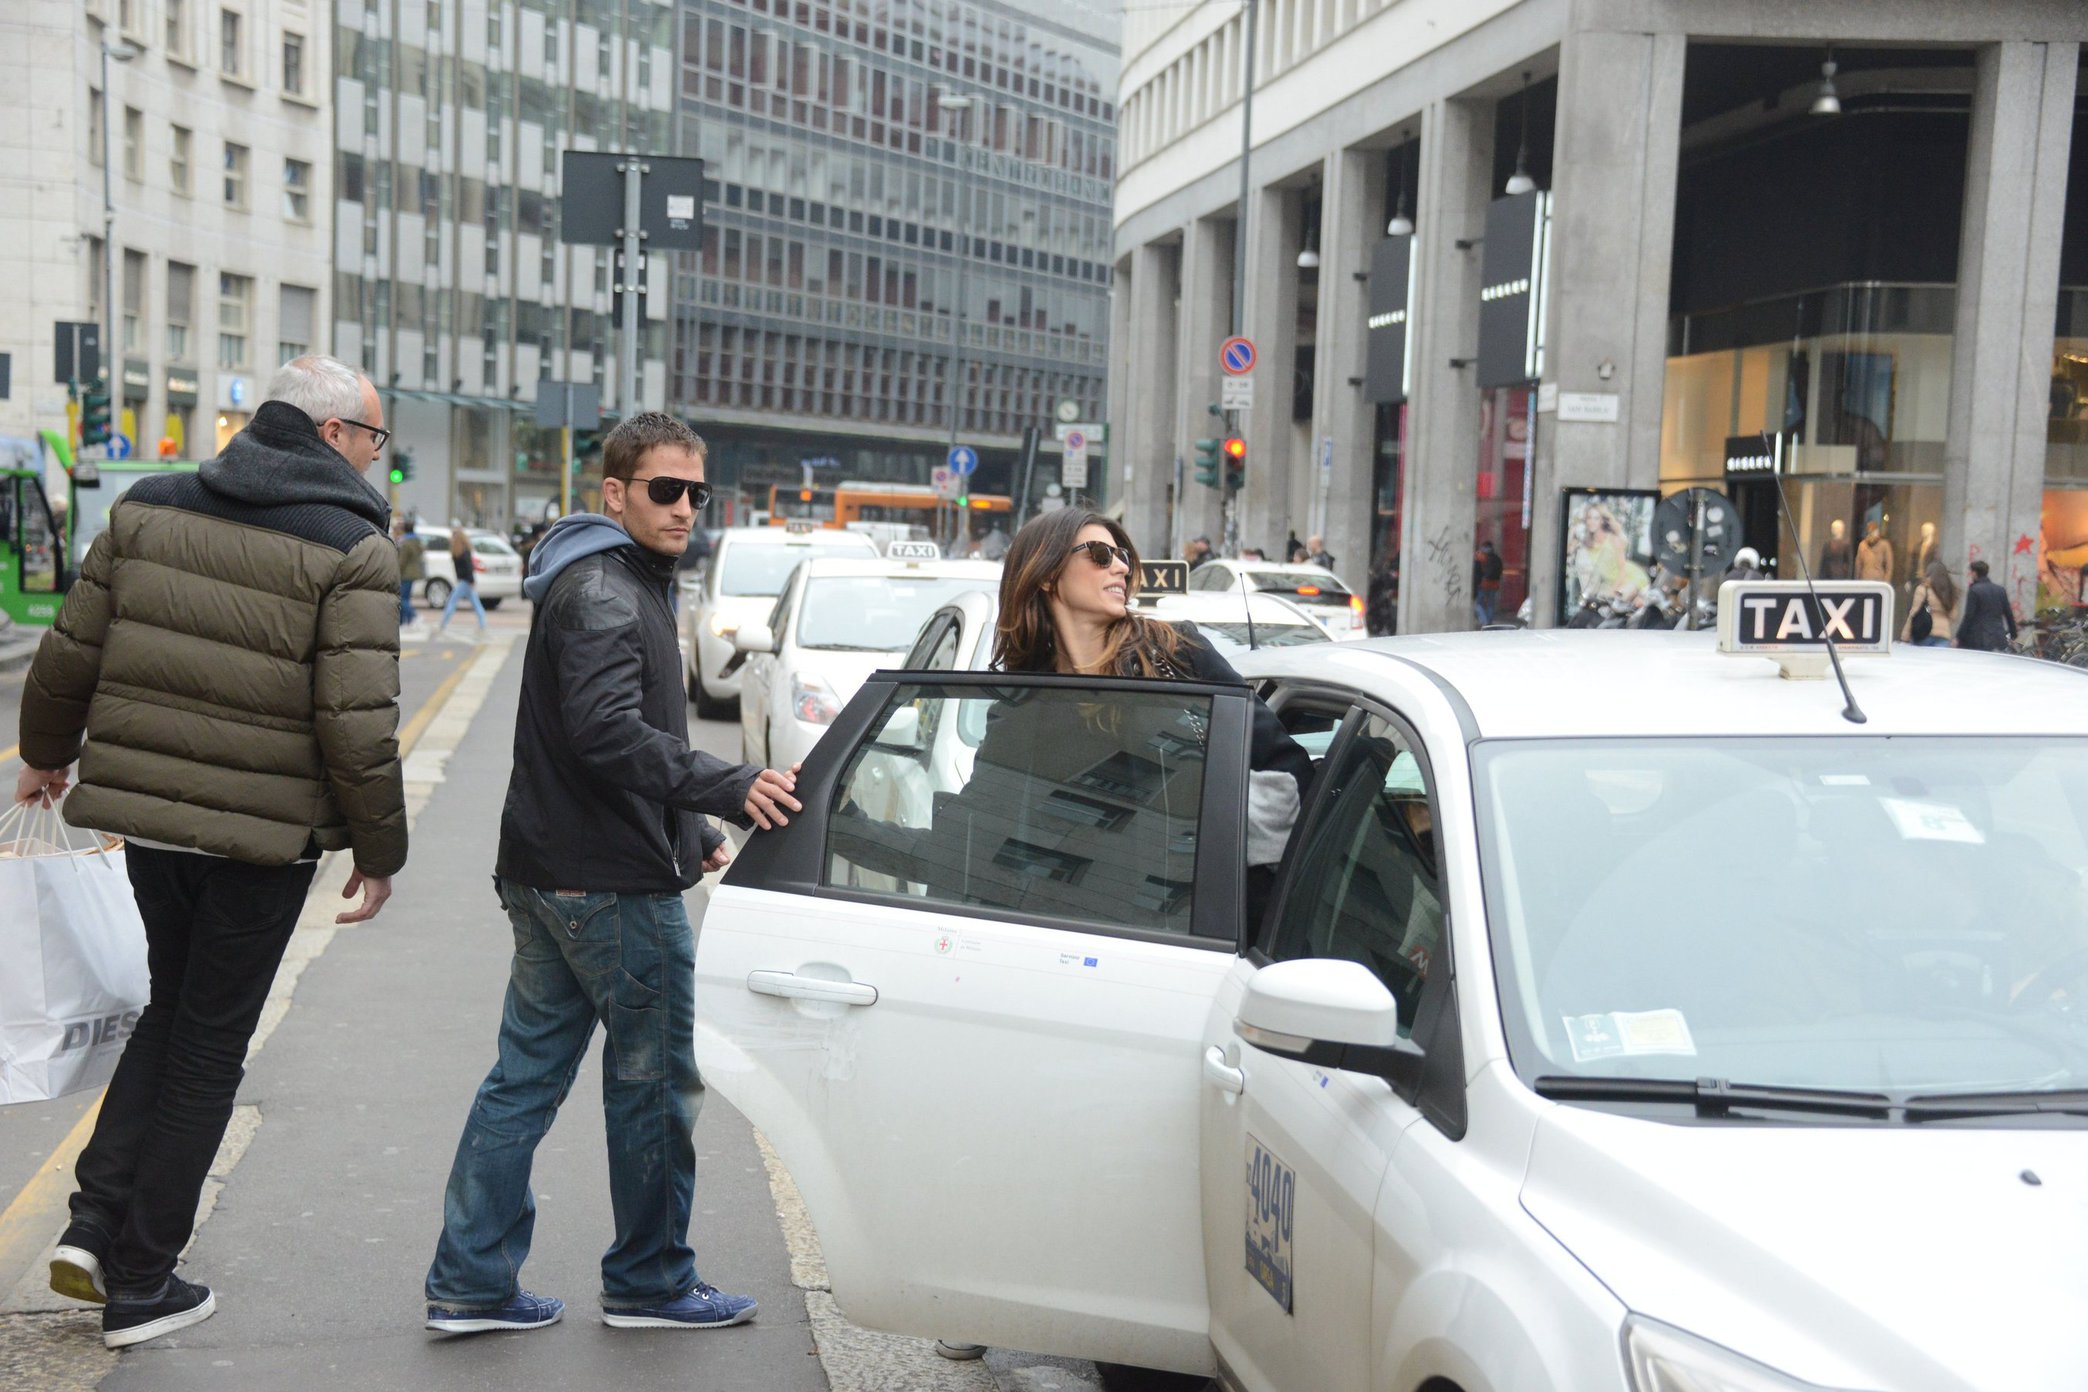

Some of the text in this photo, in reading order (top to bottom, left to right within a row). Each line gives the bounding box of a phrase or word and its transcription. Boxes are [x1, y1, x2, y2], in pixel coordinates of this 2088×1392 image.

[893, 545, 933, 557] TAXI
[1140, 568, 1180, 588] AXI
[1743, 598, 1875, 640] TAXI
[62, 1011, 140, 1051] DIES
